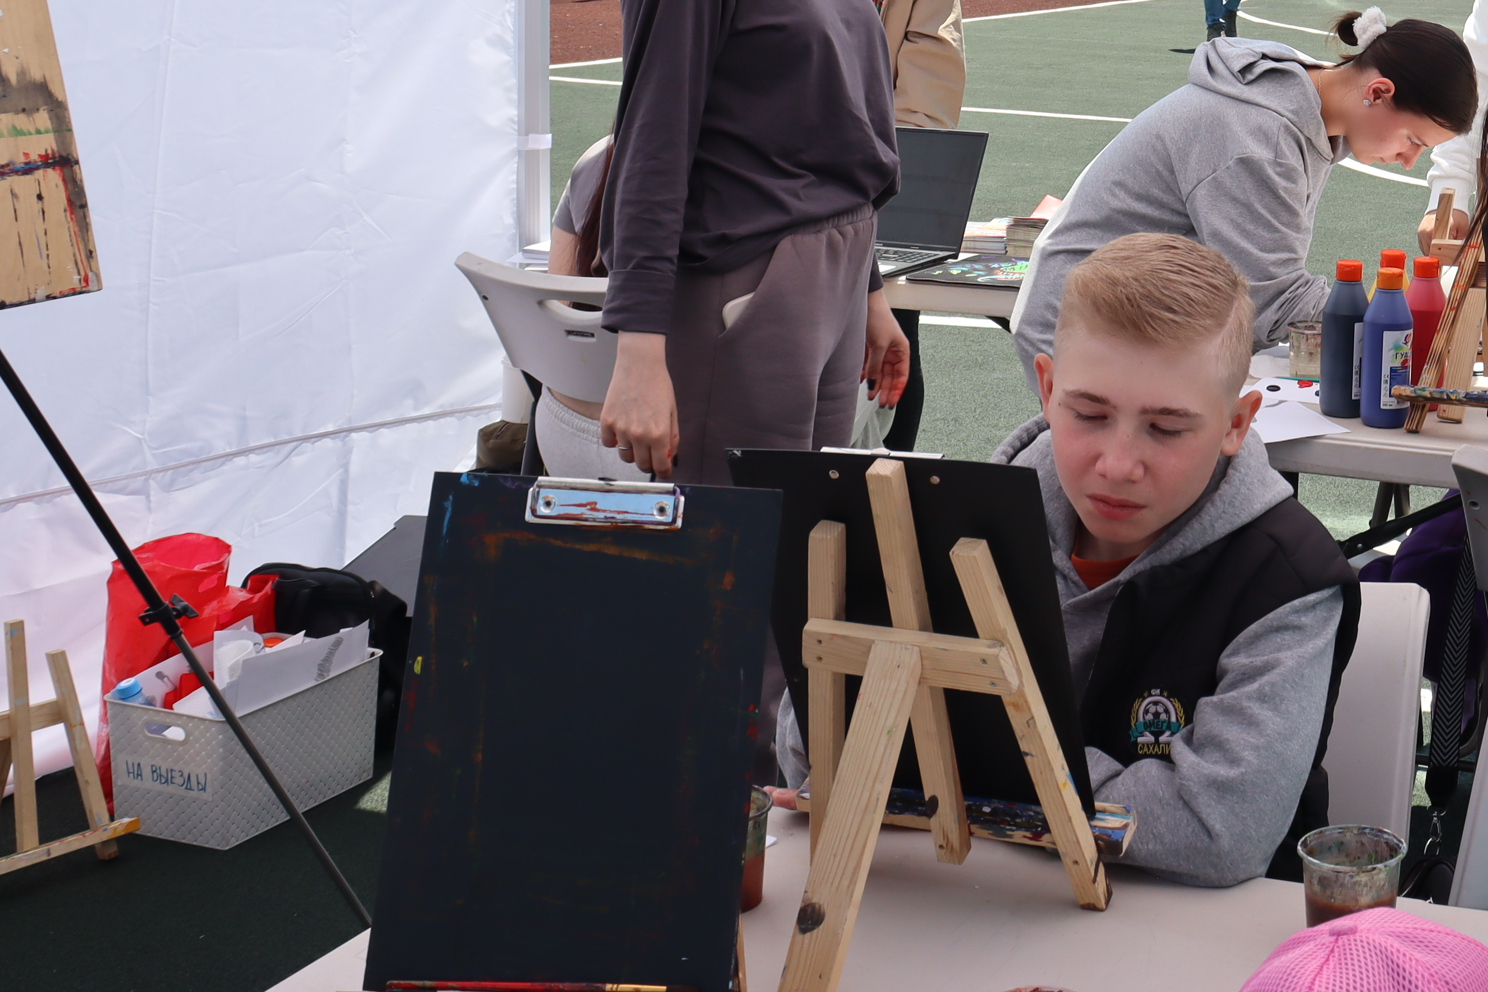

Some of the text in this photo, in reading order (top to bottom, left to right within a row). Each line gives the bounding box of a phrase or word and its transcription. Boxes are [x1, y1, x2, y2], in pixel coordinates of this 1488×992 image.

[1137, 743, 1171, 755] САХАЛИ
[125, 760, 207, 793] НА ВЫЕЗДЫ
